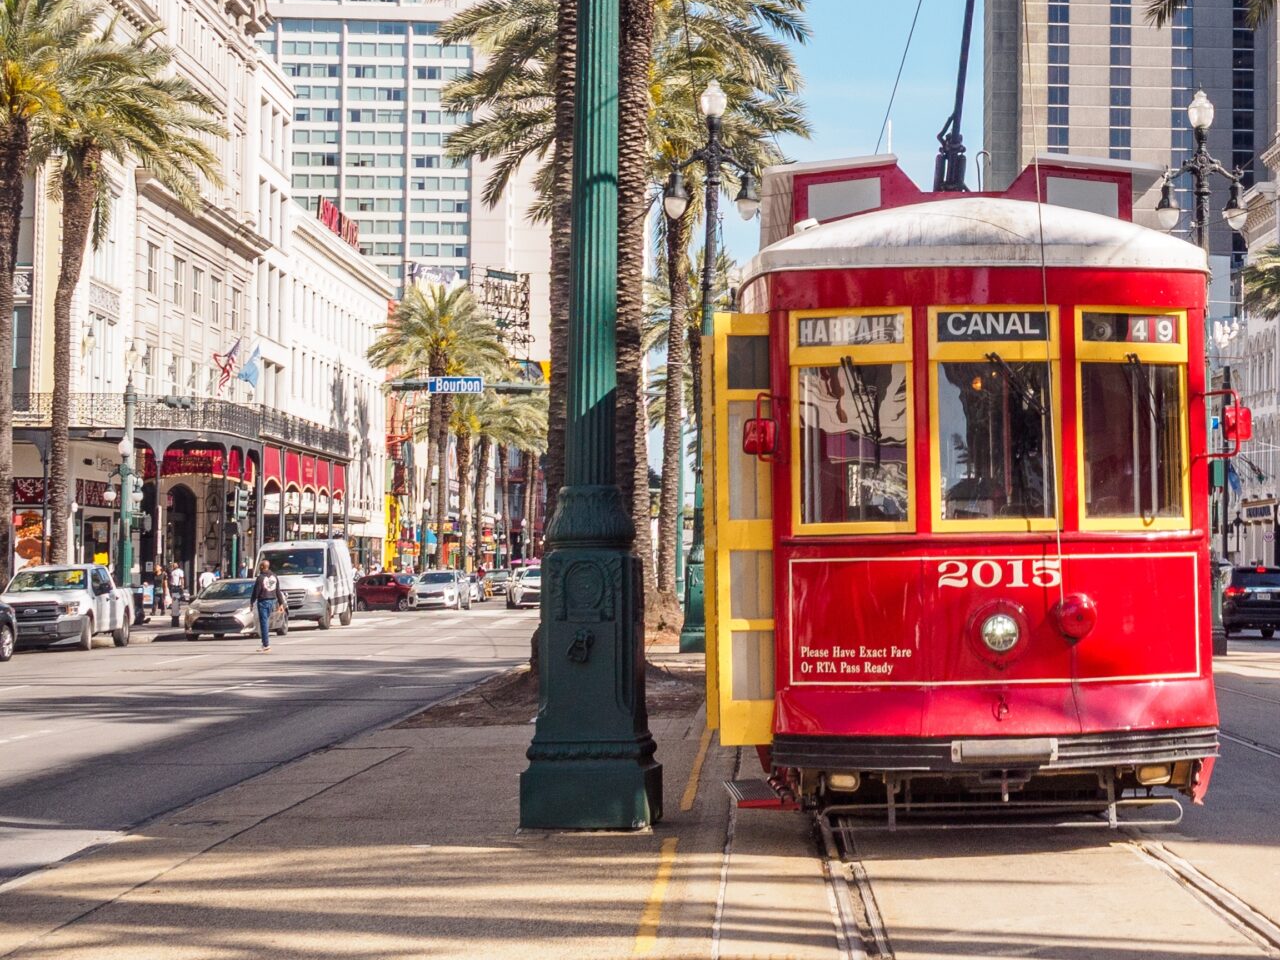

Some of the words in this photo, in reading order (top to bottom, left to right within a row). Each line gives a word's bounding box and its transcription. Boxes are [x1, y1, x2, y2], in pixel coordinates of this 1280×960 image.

[800, 315, 904, 343] HARRAH'S
[946, 312, 1039, 335] CANAL
[436, 378, 480, 391] Bourbon
[937, 560, 1061, 588] 2015
[801, 646, 829, 658] Please
[832, 646, 856, 658] Have
[859, 646, 887, 658] Exact
[891, 646, 912, 658] Fare
[801, 662, 813, 673] Or
[816, 662, 837, 673] RTA
[840, 662, 860, 673] Pass
[864, 662, 893, 675] Ready
